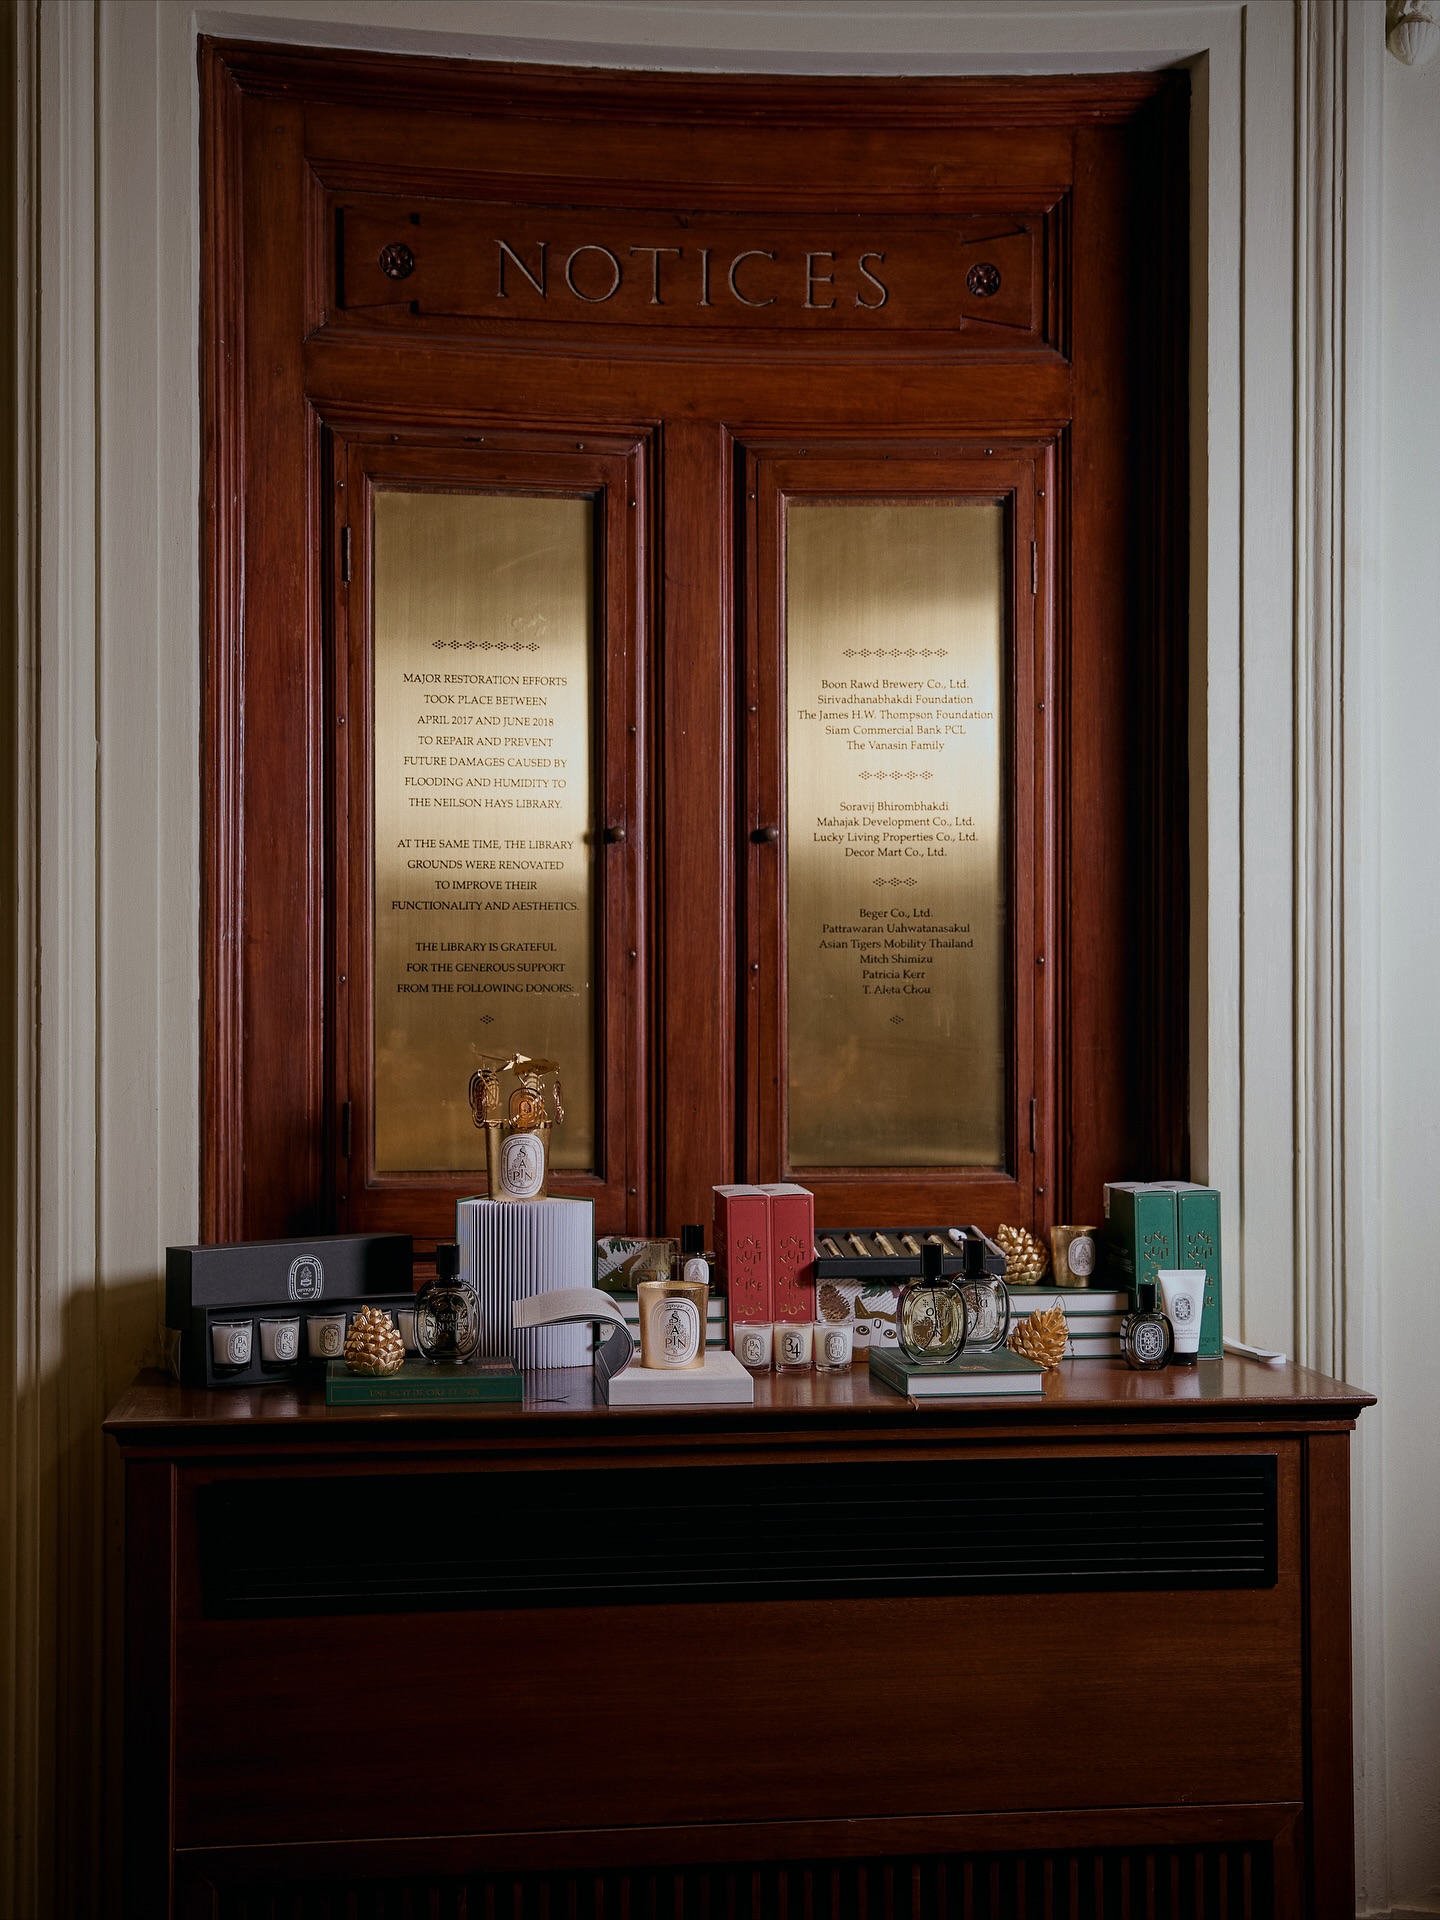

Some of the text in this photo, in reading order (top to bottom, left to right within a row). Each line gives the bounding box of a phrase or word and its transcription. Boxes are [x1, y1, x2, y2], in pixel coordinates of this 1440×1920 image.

[494, 240, 889, 310] NOTICES
[403, 674, 568, 685] MAJOR RESTORATION EFFORTS
[821, 679, 969, 691] Boon Rawd Brewery Co., Ltd.
[423, 695, 548, 705] TOOK PLACE BETWEEN
[817, 694, 973, 704] Sirivadhanabhakdi Foundation
[417, 716, 554, 727] APRIL 2017 AND JUNE 2018
[798, 710, 994, 722] The James H.W. Thompson Foundation
[825, 725, 966, 734] Siam Commercial Bank PCL
[417, 736, 553, 746] TO REPAIR AND PREVENT
[846, 740, 945, 752] The Vanasin Family
[403, 757, 568, 767] FUTURE DAMAGES CAUSED BY
[404, 777, 567, 788] FLOODING AND HUMIDITY TO
[408, 798, 562, 808] THE NEILSON HAYS LIBRARY.
[839, 801, 949, 813] Soravij Bhirombhakdi
[816, 817, 975, 829] Mahajak Development Co., Ltd.
[813, 832, 979, 844] Lucky Living Properties Co., Ltd.
[397, 839, 574, 849] AT THE SAME TIME, THE LIBRARY
[845, 847, 947, 857] Decor Mart Co., Ltd.
[407, 860, 564, 870] GROUNDS WERE RENOVATED
[435, 881, 537, 890] TO IMPROVE THEIR
[391, 901, 579, 910] FUNCTIONALITY AND AESTHETICS.
[859, 908, 934, 920] Beger Co., Ltd.
[822, 923, 971, 933] Pattrawaran Uahwatanasakul
[415, 943, 557, 951] THE LIBRARY IS GRATEFUL
[819, 938, 974, 951] Asian Tigers Mobility Thailand
[860, 954, 933, 963] Mitch Shimizu
[406, 963, 565, 972] FOR THE GENEROUS SUPPORT
[862, 970, 926, 979] Patricia Kerr
[397, 984, 575, 992] FROM THE FOLLOWING DONORS:
[862, 984, 931, 994] T. Aleta Chou
[736, 1235, 761, 1249] UNE
[780, 1234, 805, 1249] UNE
[1143, 1230, 1169, 1245] UNE
[1187, 1230, 1213, 1245] UNE
[736, 1250, 763, 1264] NUIT
[780, 1250, 806, 1264] NUIT
[1143, 1246, 1170, 1260] NUIT
[1187, 1246, 1214, 1260] NUIT
[736, 1277, 762, 1291] CIRE
[436, 1322, 463, 1331] ROSE
[665, 1312, 687, 1349] SAPIN
[785, 1338, 801, 1358] 34
